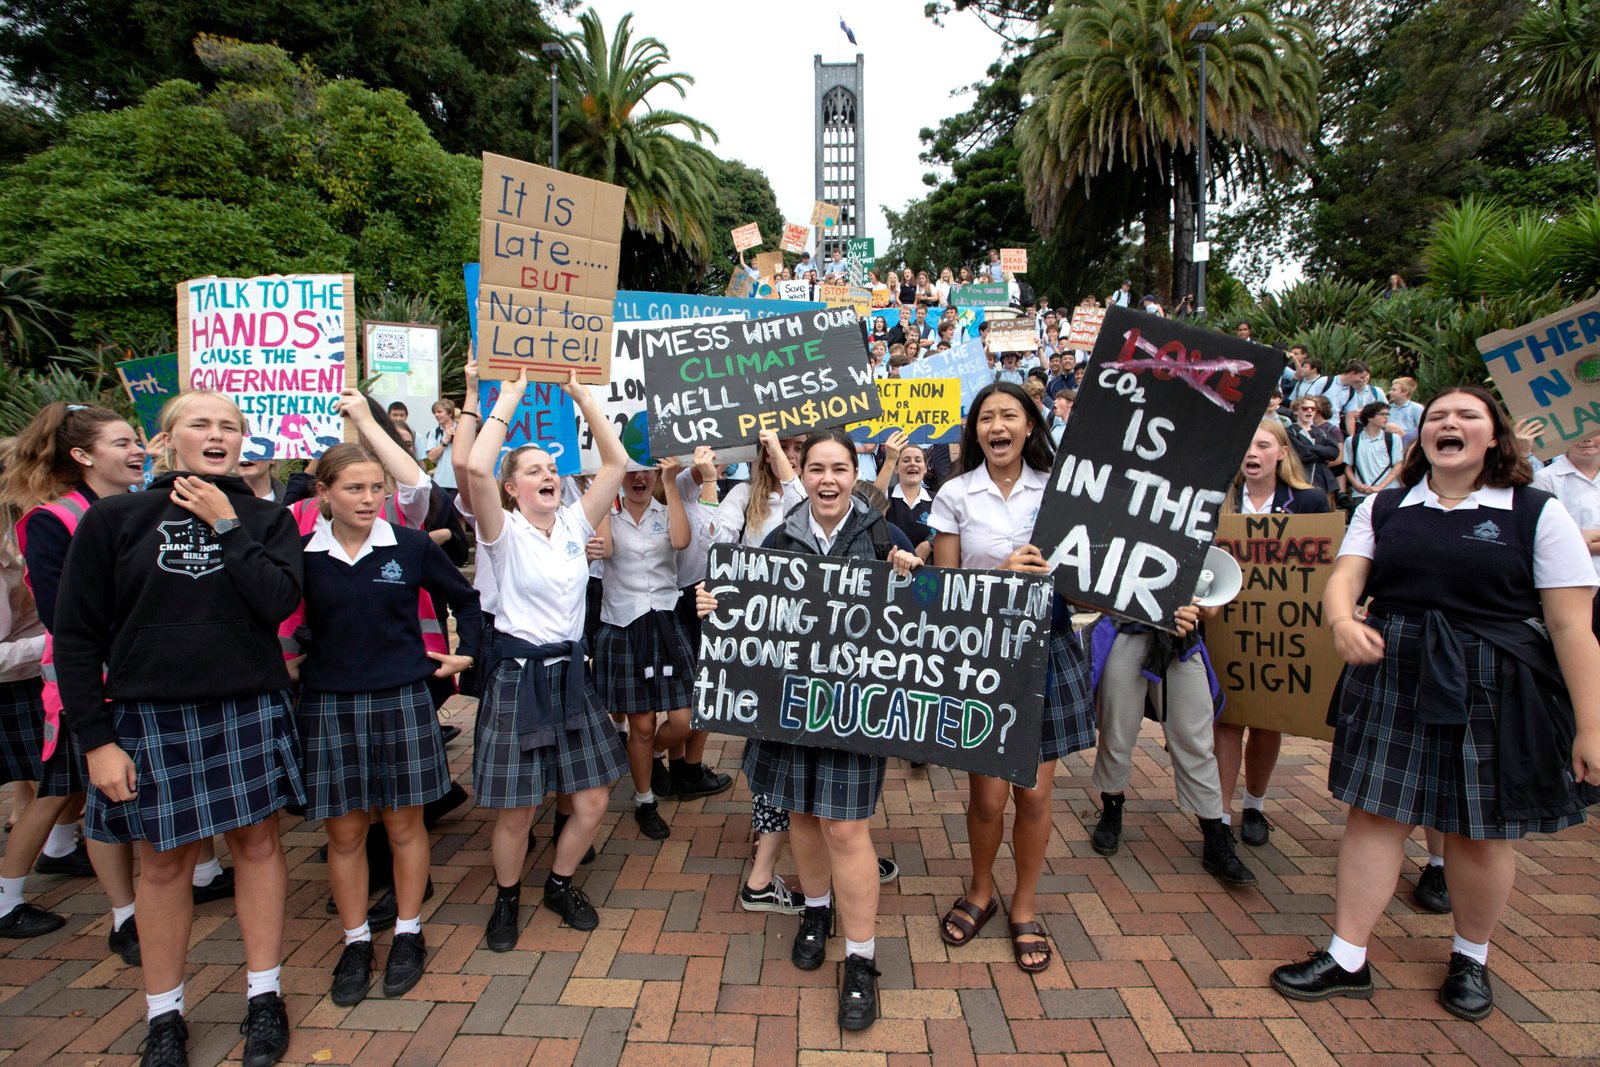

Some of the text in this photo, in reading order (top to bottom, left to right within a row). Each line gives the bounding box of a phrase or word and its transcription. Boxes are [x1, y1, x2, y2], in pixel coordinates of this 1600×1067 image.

[498, 175, 575, 226] It is
[847, 240, 868, 250] SAVE
[521, 266, 580, 292] BUT
[785, 284, 806, 293] Save
[824, 287, 848, 296] STOP
[190, 280, 343, 312] TALK TO THE
[489, 291, 603, 332] Not too
[648, 303, 672, 320] GO
[679, 303, 722, 320] BACK
[191, 310, 320, 352] HANDS
[492, 325, 599, 363] Late!!
[645, 325, 730, 358] MESS
[742, 316, 803, 344] WITH
[813, 307, 858, 331] OUR
[201, 349, 296, 365] CAUSE THE
[680, 339, 826, 383] CLIMATE
[190, 364, 345, 393] GOVERNMENT
[753, 367, 838, 405] MESS
[910, 383, 944, 398] NOW
[672, 417, 723, 444] UR
[737, 391, 870, 437] PEN$ION
[896, 400, 909, 409] OR
[906, 410, 950, 424] LATER
[505, 409, 556, 442] WE
[1122, 409, 1175, 460] IS
[1056, 454, 1226, 540] IN THE
[1246, 516, 1289, 539] MY
[183, 552, 209, 560] GIRLS
[710, 548, 808, 591] WHATS
[819, 562, 872, 597] THE
[1047, 524, 1177, 622] AIR
[1241, 565, 1316, 593] AN'T
[710, 585, 818, 635] GOING
[827, 601, 871, 639] TO
[1001, 618, 1036, 659] if
[1223, 600, 1323, 627] FIT ON
[1234, 630, 1306, 658] THIS
[953, 659, 1000, 694] to
[1226, 661, 1312, 694] SIGN
[694, 666, 1017, 754] the EDUCATED?
